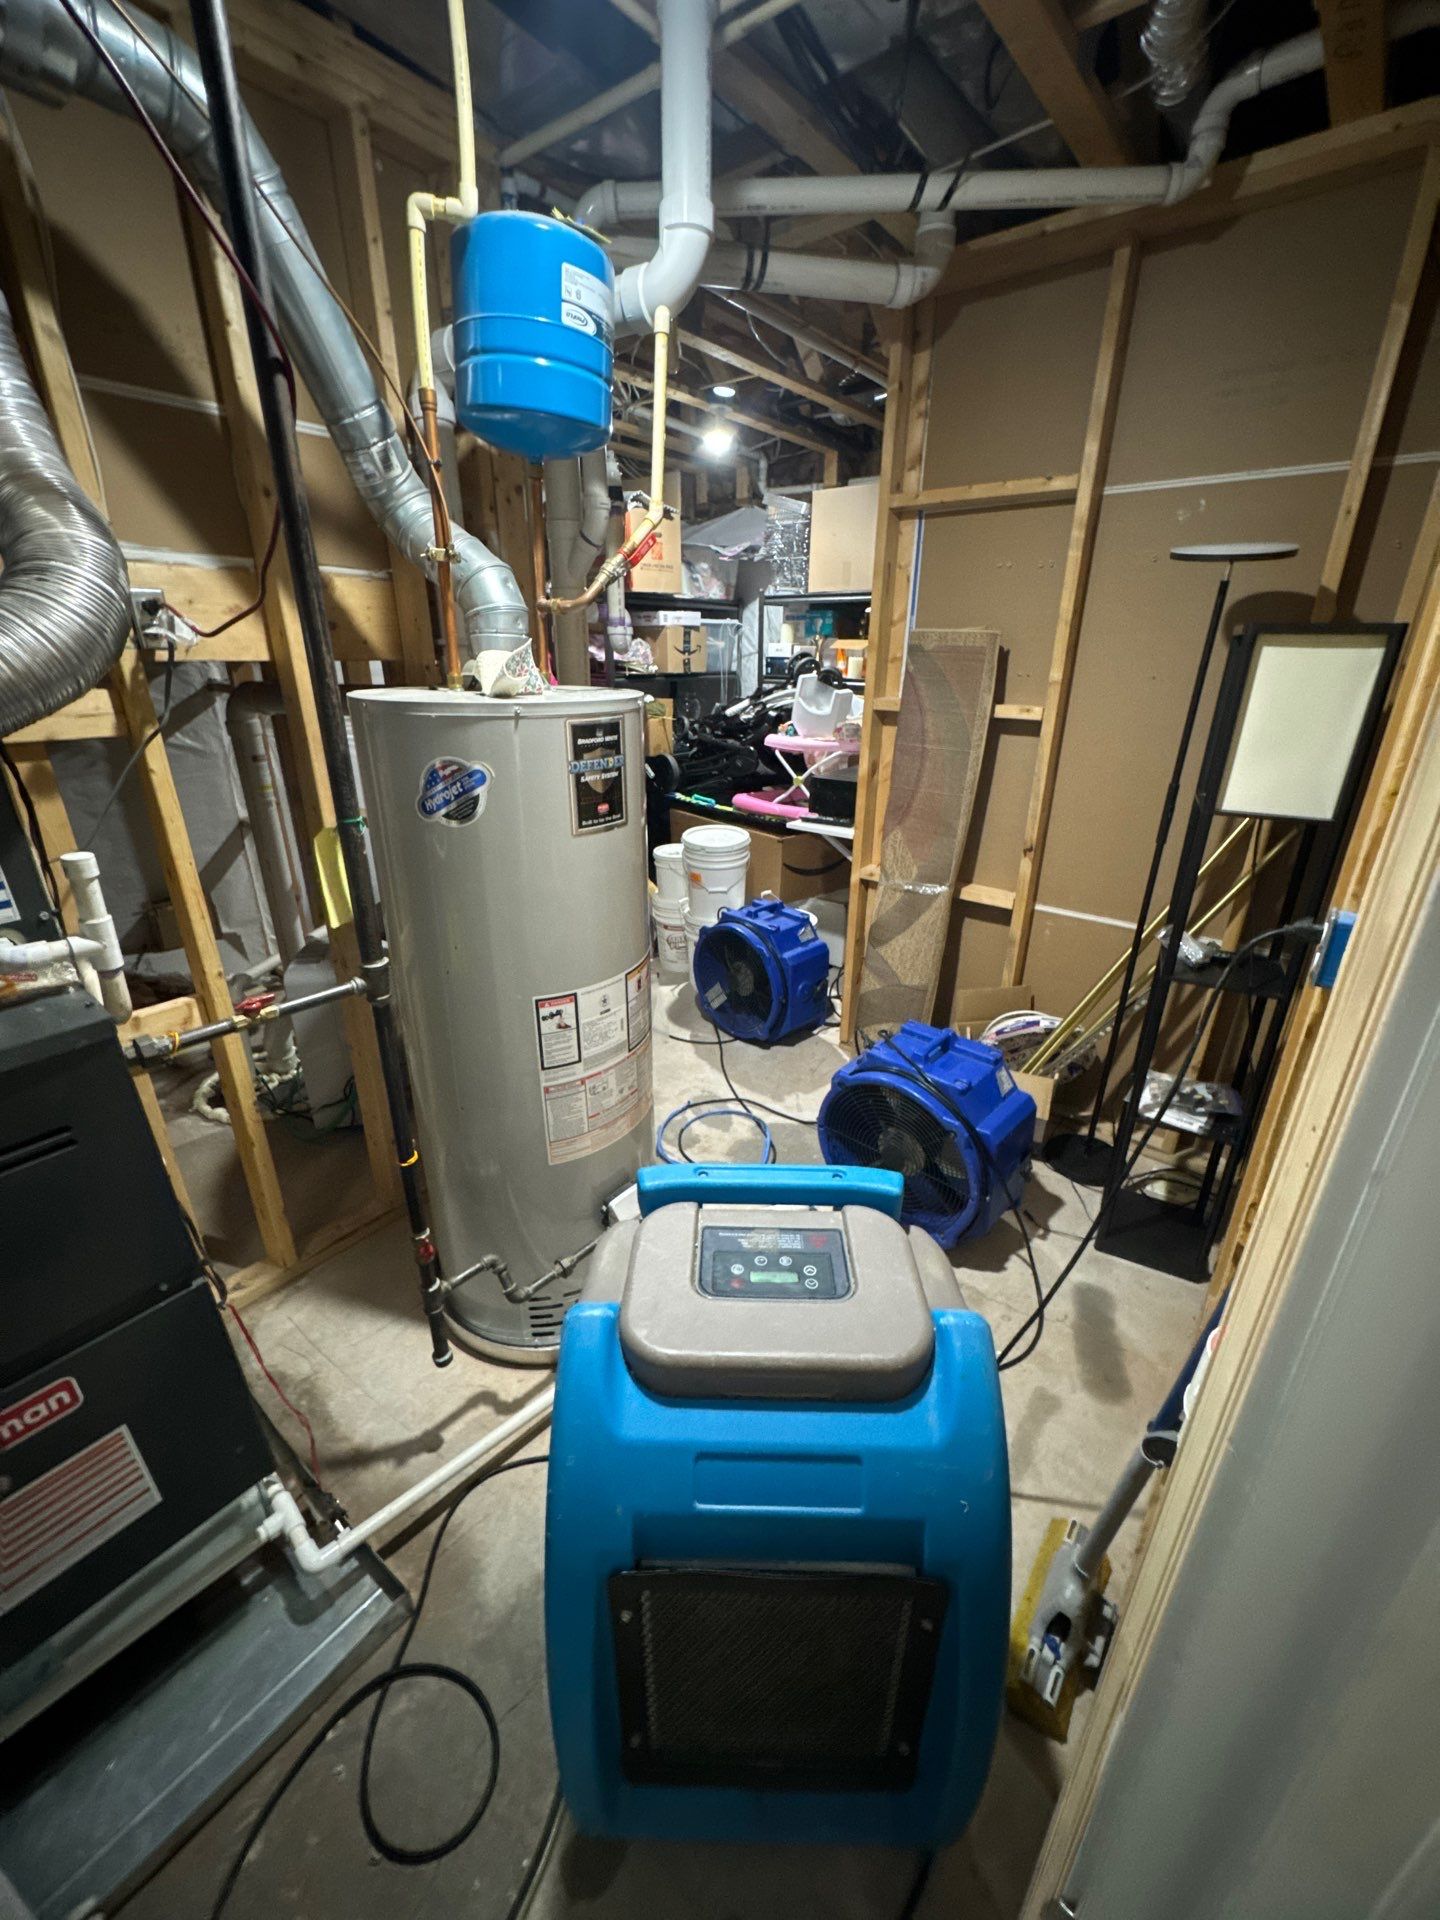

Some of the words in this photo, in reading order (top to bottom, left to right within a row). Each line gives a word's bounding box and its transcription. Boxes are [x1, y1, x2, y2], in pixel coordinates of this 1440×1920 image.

[577, 737, 604, 745] BRADFORD
[569, 754, 625, 774] DEFENDER
[580, 774, 601, 783] SAFETY
[425, 781, 463, 811] Hydrojet
